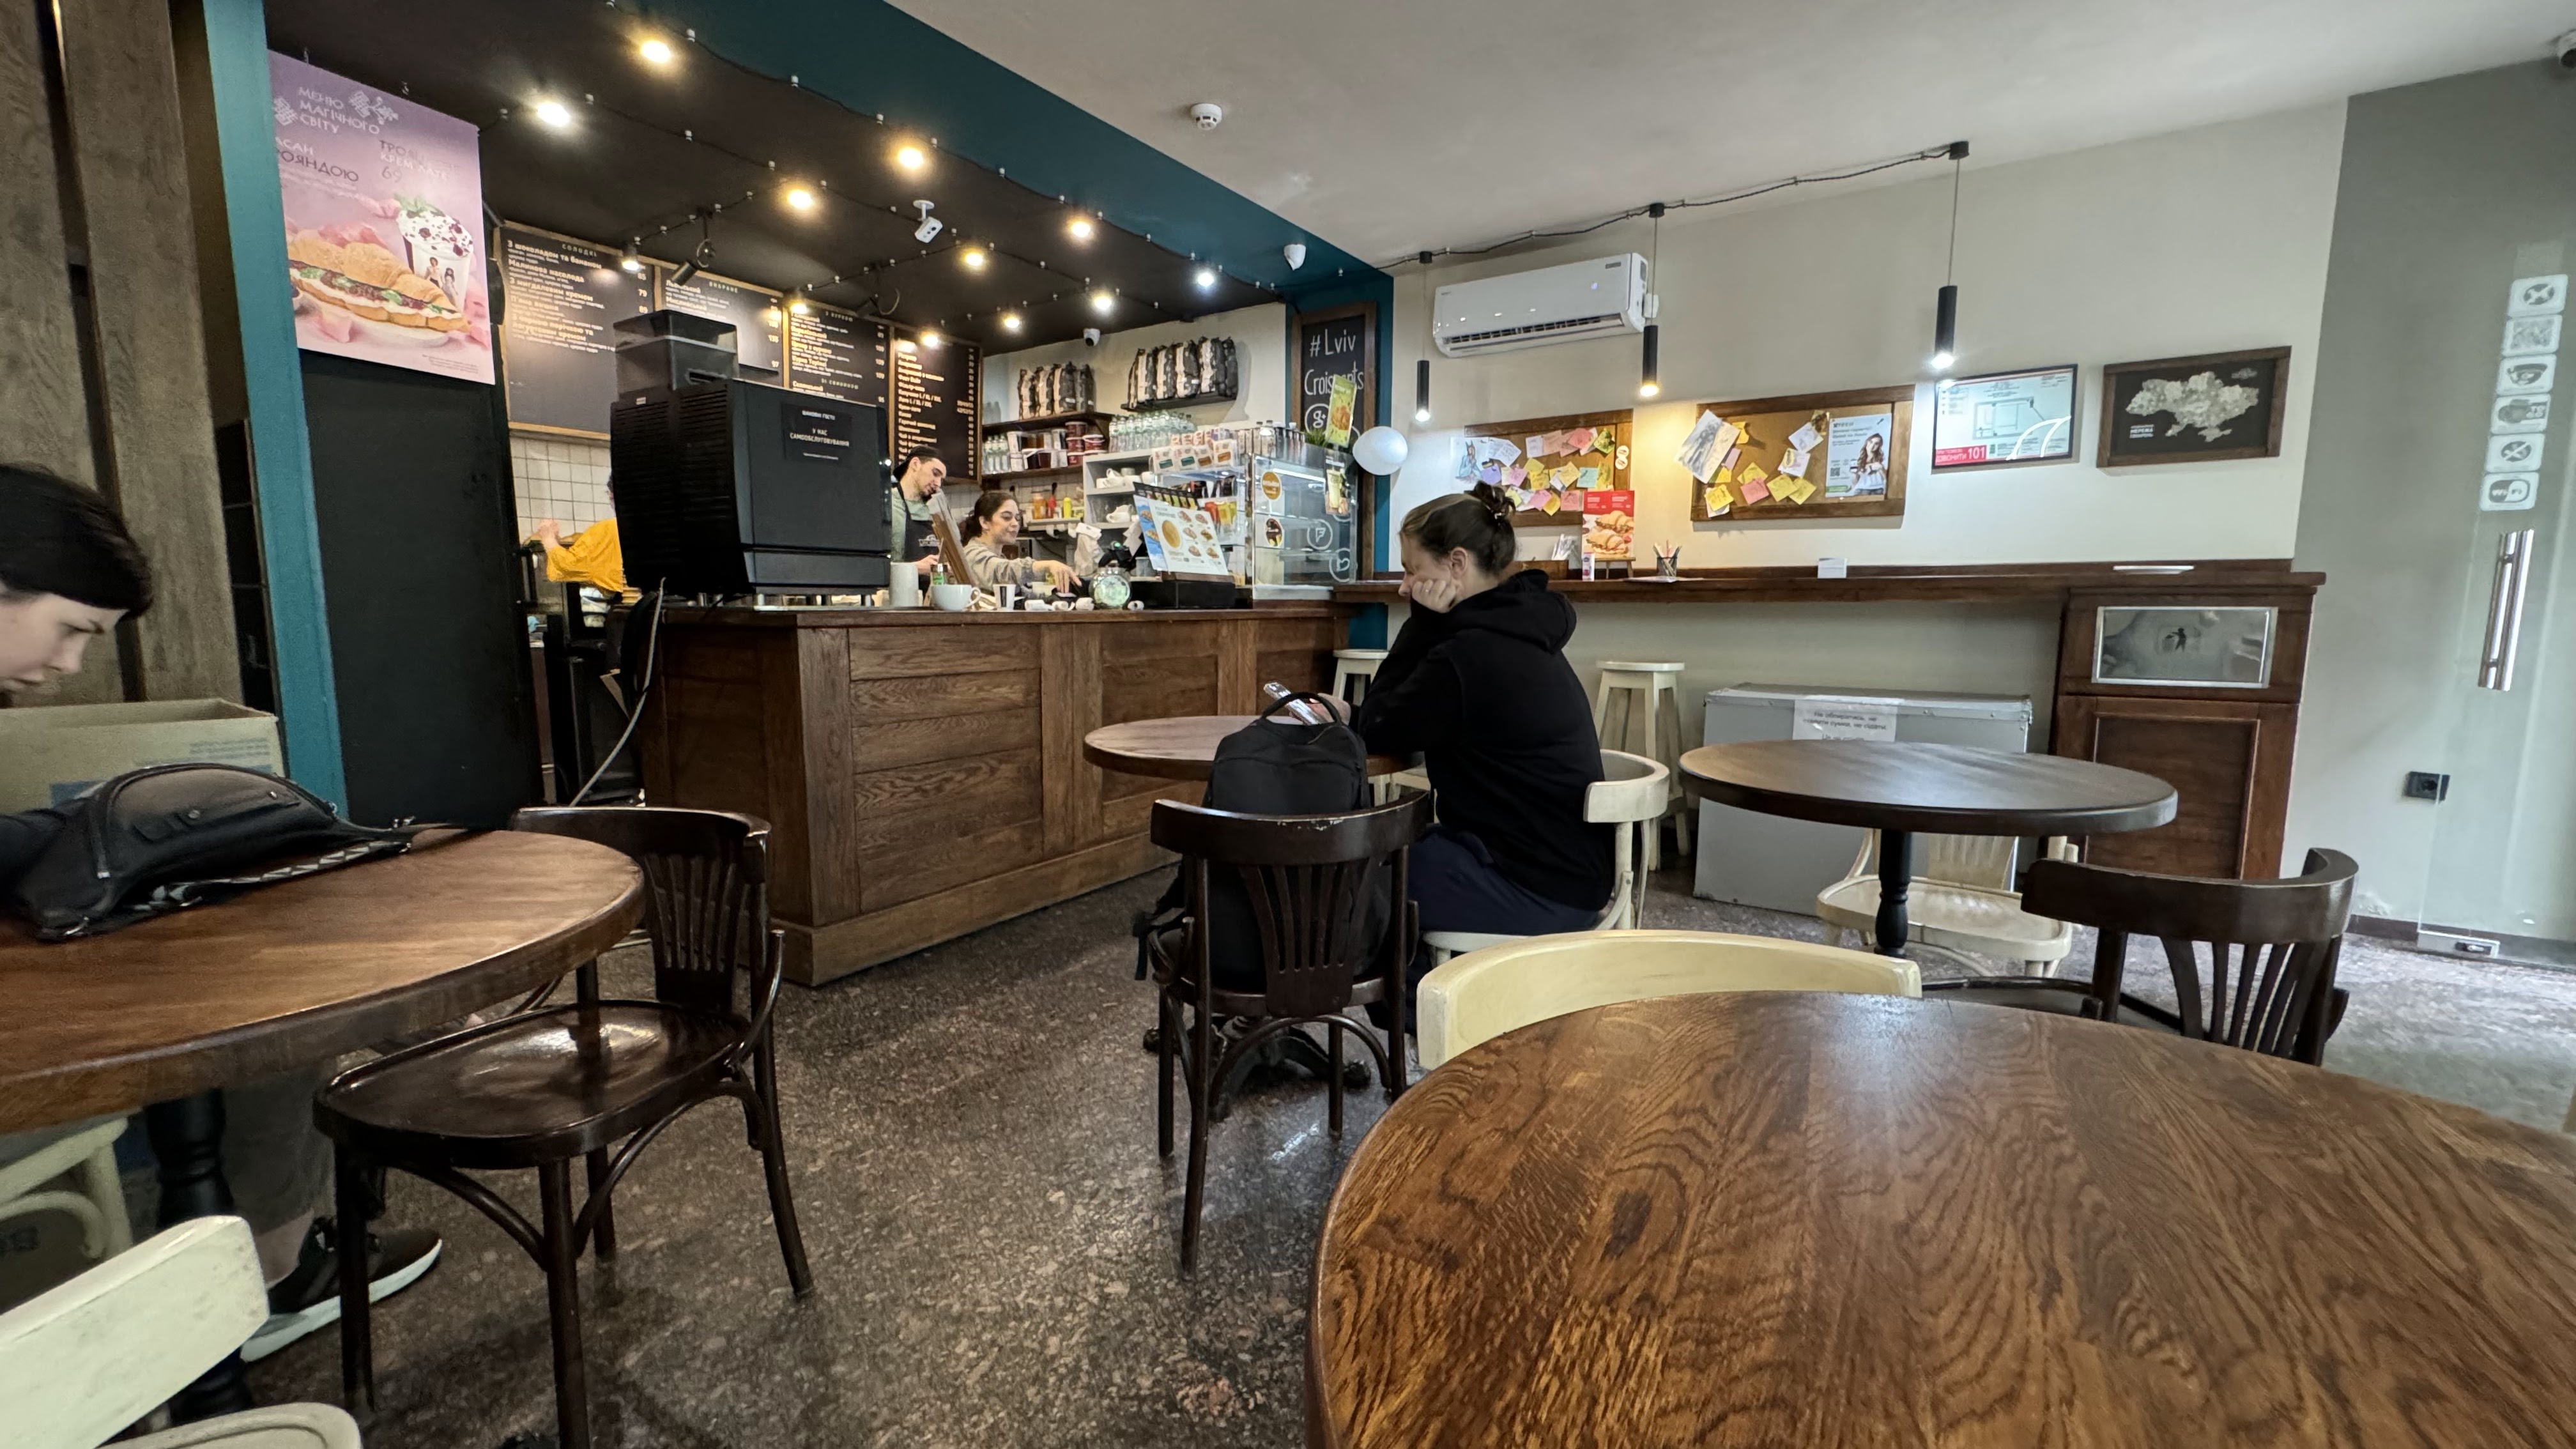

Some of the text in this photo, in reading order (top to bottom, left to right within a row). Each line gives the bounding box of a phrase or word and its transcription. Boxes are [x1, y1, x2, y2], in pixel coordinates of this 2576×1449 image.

[300, 100, 380, 135] МАГІЧНОГО
[300, 113, 339, 134] СВІТУ
[275, 147, 359, 182] ОЯНДОЮ
[381, 166, 402, 183] 69
[1304, 360, 1364, 396] Croisnts
[1968, 447, 1986, 460] 101
